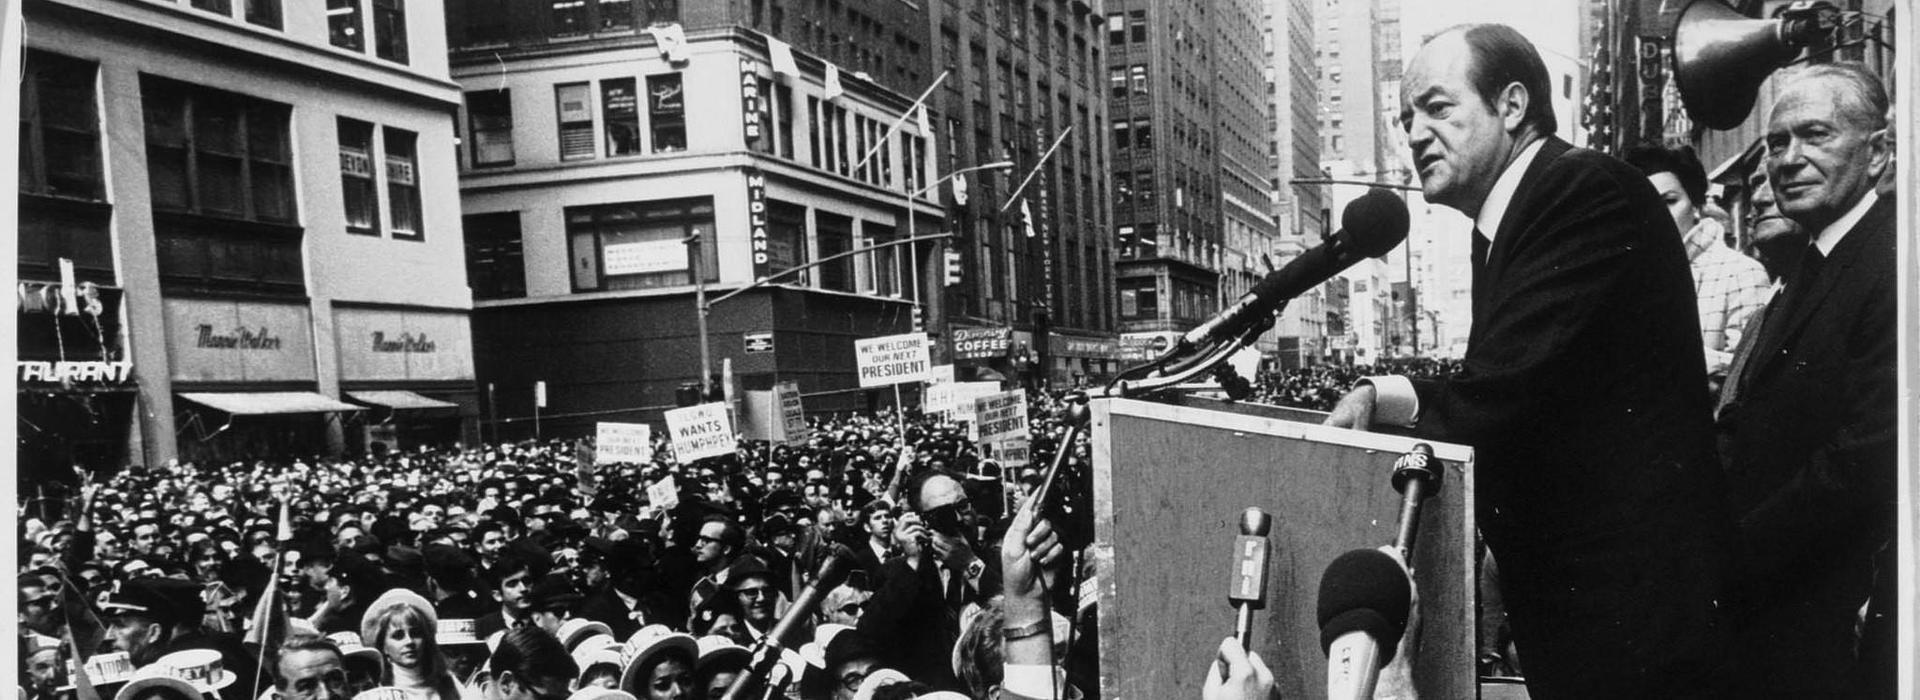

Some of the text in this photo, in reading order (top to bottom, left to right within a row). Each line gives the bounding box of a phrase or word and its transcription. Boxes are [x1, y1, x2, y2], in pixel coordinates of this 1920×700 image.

[741, 60, 759, 136] MARINE
[749, 175, 767, 264] MIDLAND
[861, 338, 922, 354] WE WELCOME
[955, 338, 1008, 352] COFFEE
[872, 350, 917, 364] OUR NEXT
[861, 359, 926, 380] PRESIDENT
[679, 420, 722, 438] WANTS
[978, 415, 1025, 438] PRESIDENT
[677, 433, 731, 455] HUMPHREY
